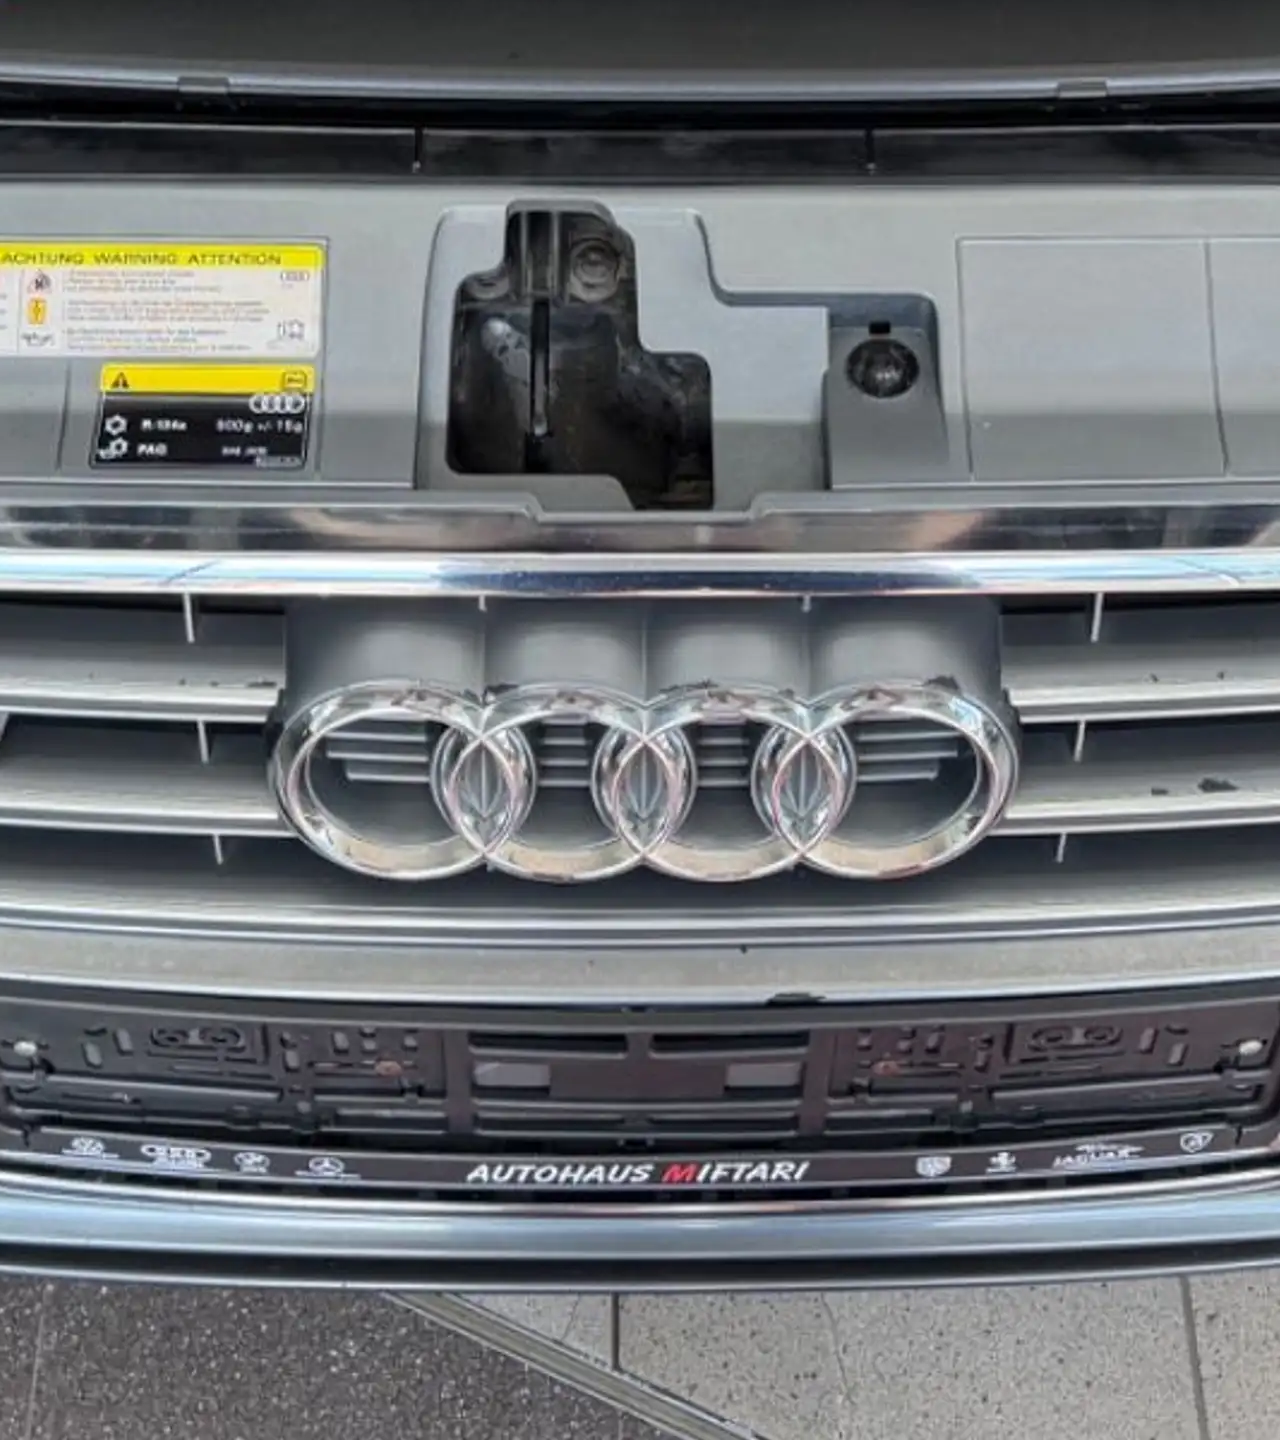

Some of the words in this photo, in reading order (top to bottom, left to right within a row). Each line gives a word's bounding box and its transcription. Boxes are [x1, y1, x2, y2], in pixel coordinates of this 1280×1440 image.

[2, 252, 84, 265] ACHTUNG
[93, 252, 177, 265] WARNING
[188, 252, 282, 265] ATTENTION
[466, 1163, 654, 1185] AUTOHAUS
[660, 1160, 812, 1184] MIFTARI
